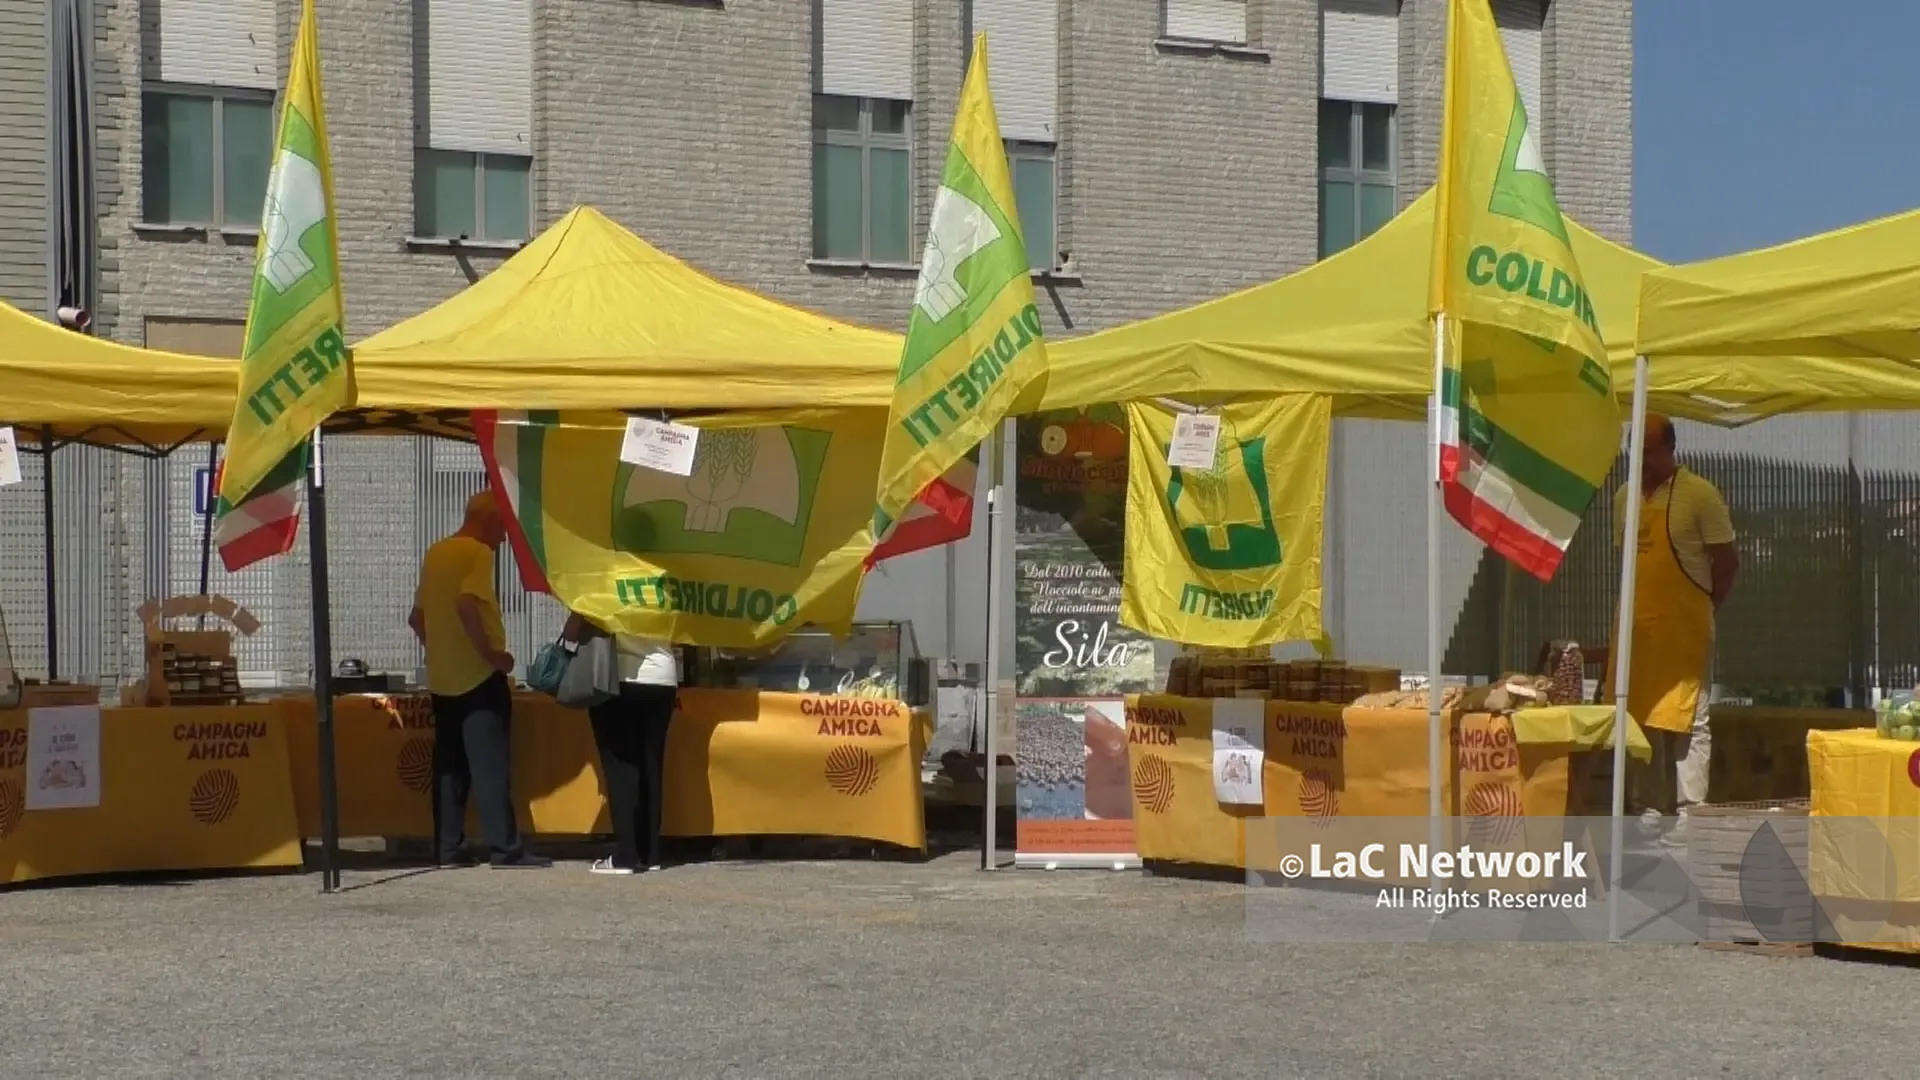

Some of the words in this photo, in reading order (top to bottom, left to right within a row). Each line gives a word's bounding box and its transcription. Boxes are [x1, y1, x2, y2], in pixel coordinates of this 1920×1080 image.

[1024, 563, 1051, 579] Dal
[1053, 564, 1084, 579] 2010
[1043, 619, 1138, 668] Sila
[800, 699, 900, 717] CAMPAGNA
[172, 721, 267, 742] CAMPAGNA
[817, 719, 882, 737] AMICA
[1129, 725, 1177, 746] AMICA
[1275, 713, 1348, 738] CAMPAGNA
[187, 742, 250, 761] AMICA
[1291, 738, 1338, 759] AMICA
[1459, 747, 1516, 773] AMICA
